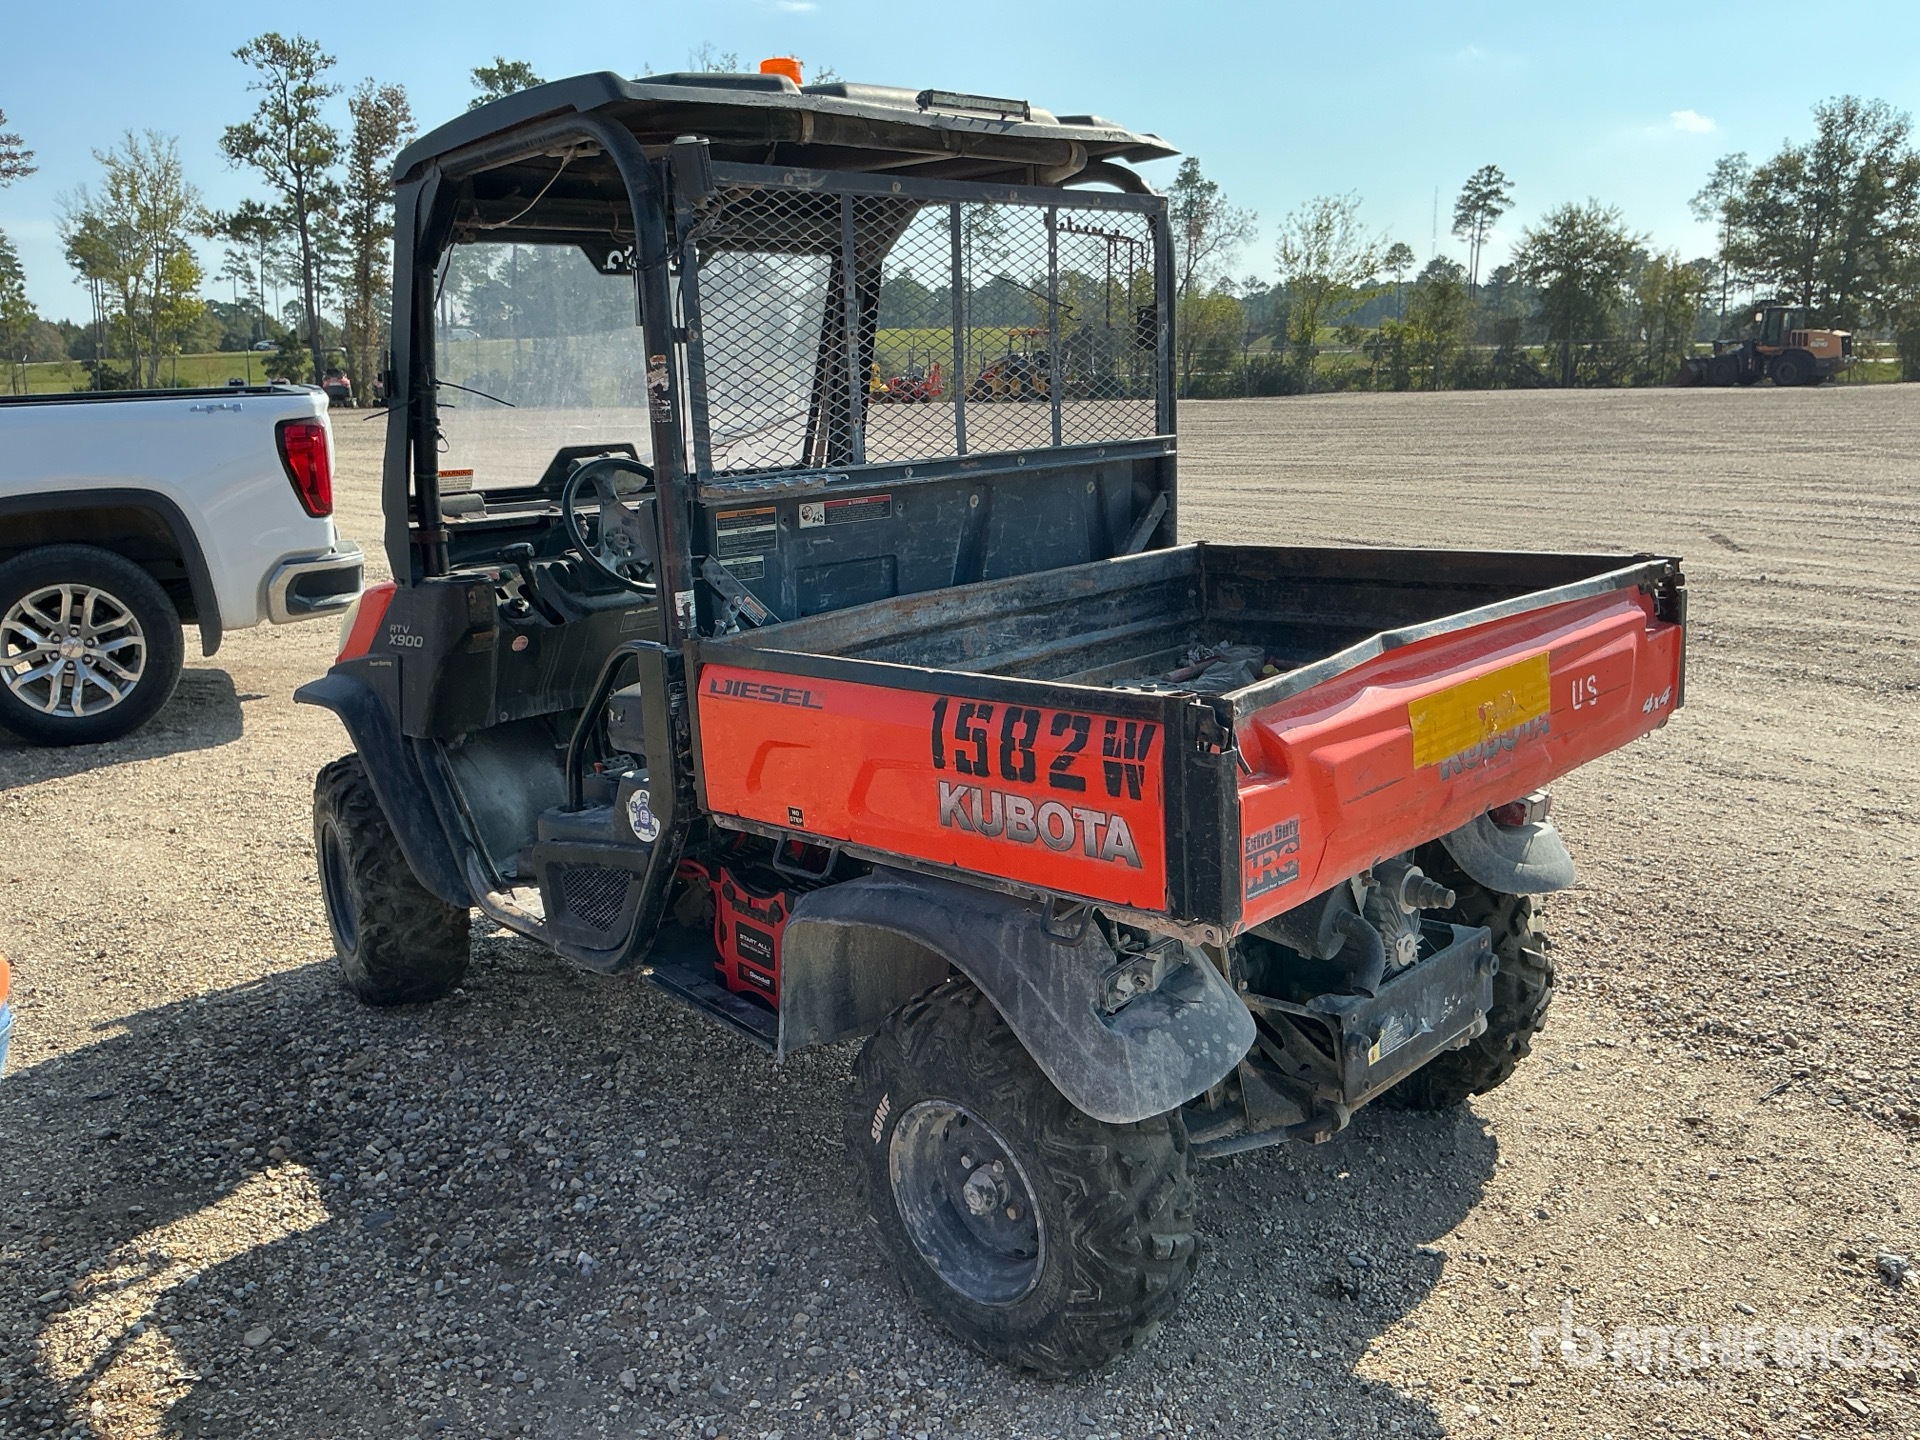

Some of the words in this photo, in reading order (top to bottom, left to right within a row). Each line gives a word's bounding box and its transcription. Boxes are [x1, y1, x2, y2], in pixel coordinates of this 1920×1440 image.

[390, 624, 410, 634] RTV
[389, 634, 424, 648] X900
[710, 678, 823, 709] DIESEL
[938, 780, 1144, 870] KUBOTA
[1246, 831, 1272, 855] Extra
[1274, 819, 1299, 841] Duty
[740, 933, 757, 945] START
